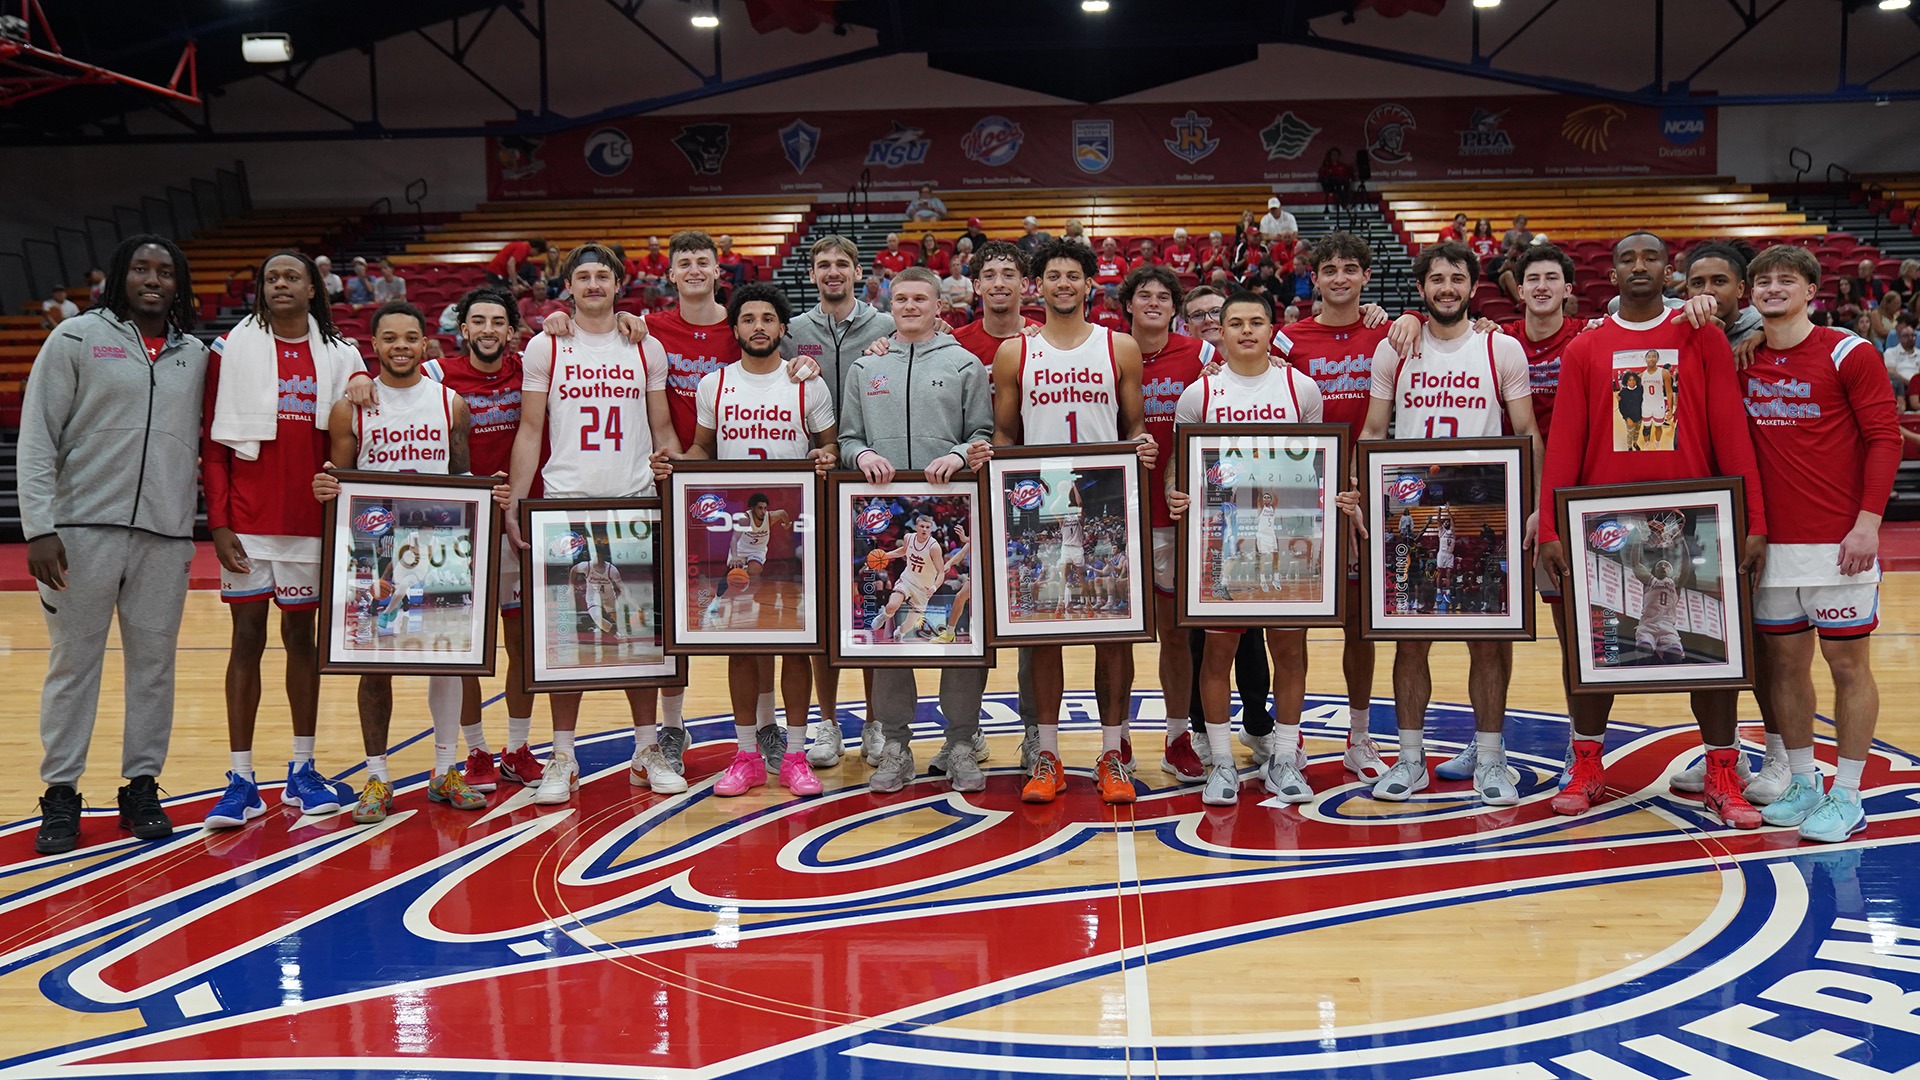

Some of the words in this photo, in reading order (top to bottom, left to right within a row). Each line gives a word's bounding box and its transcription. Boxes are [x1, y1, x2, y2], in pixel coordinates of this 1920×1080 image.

[1663, 120, 1705, 134] NCAA
[961, 122, 1024, 160] Mocs
[1462, 132, 1510, 146] PBA
[610, 141, 631, 157] EC
[867, 142, 928, 166] NSU
[1658, 147, 1697, 157] Division
[92, 345, 126, 354] FLORIDA
[565, 364, 635, 381] Florida
[1034, 368, 1103, 387] Florida
[1411, 371, 1480, 389] Florida
[559, 382, 640, 400] Southern
[1030, 386, 1109, 407] Southern
[1322, 392, 1365, 401] BASKETBALL
[1648, 385, 1655, 395] 0
[1748, 378, 1811, 399] Florida
[1403, 390, 1487, 409] Southern
[724, 404, 792, 422] Florida
[1215, 403, 1286, 423] Florida
[1756, 418, 1797, 427] BASKETBALL
[371, 424, 441, 445] Florida
[474, 424, 516, 434] BASKETBALL
[580, 405, 624, 452] 24
[721, 423, 797, 442] Southern
[1064, 411, 1078, 443] 1
[367, 443, 445, 464] Southern
[1387, 479, 1426, 500] Mocs
[689, 498, 727, 519] Mocs
[354, 510, 396, 532] Mocs
[855, 508, 893, 530] Mocs
[1589, 525, 1631, 549] Mocs
[911, 563, 923, 573] 77
[1212, 550, 1223, 598] SMITH
[1395, 543, 1409, 613] BUCCINO
[277, 586, 313, 597] MOCS
[1660, 592, 1667, 606] 0
[1815, 606, 1858, 620] MOCS
[1592, 610, 1607, 663] AMARE
[1603, 608, 1619, 664] MILLER
